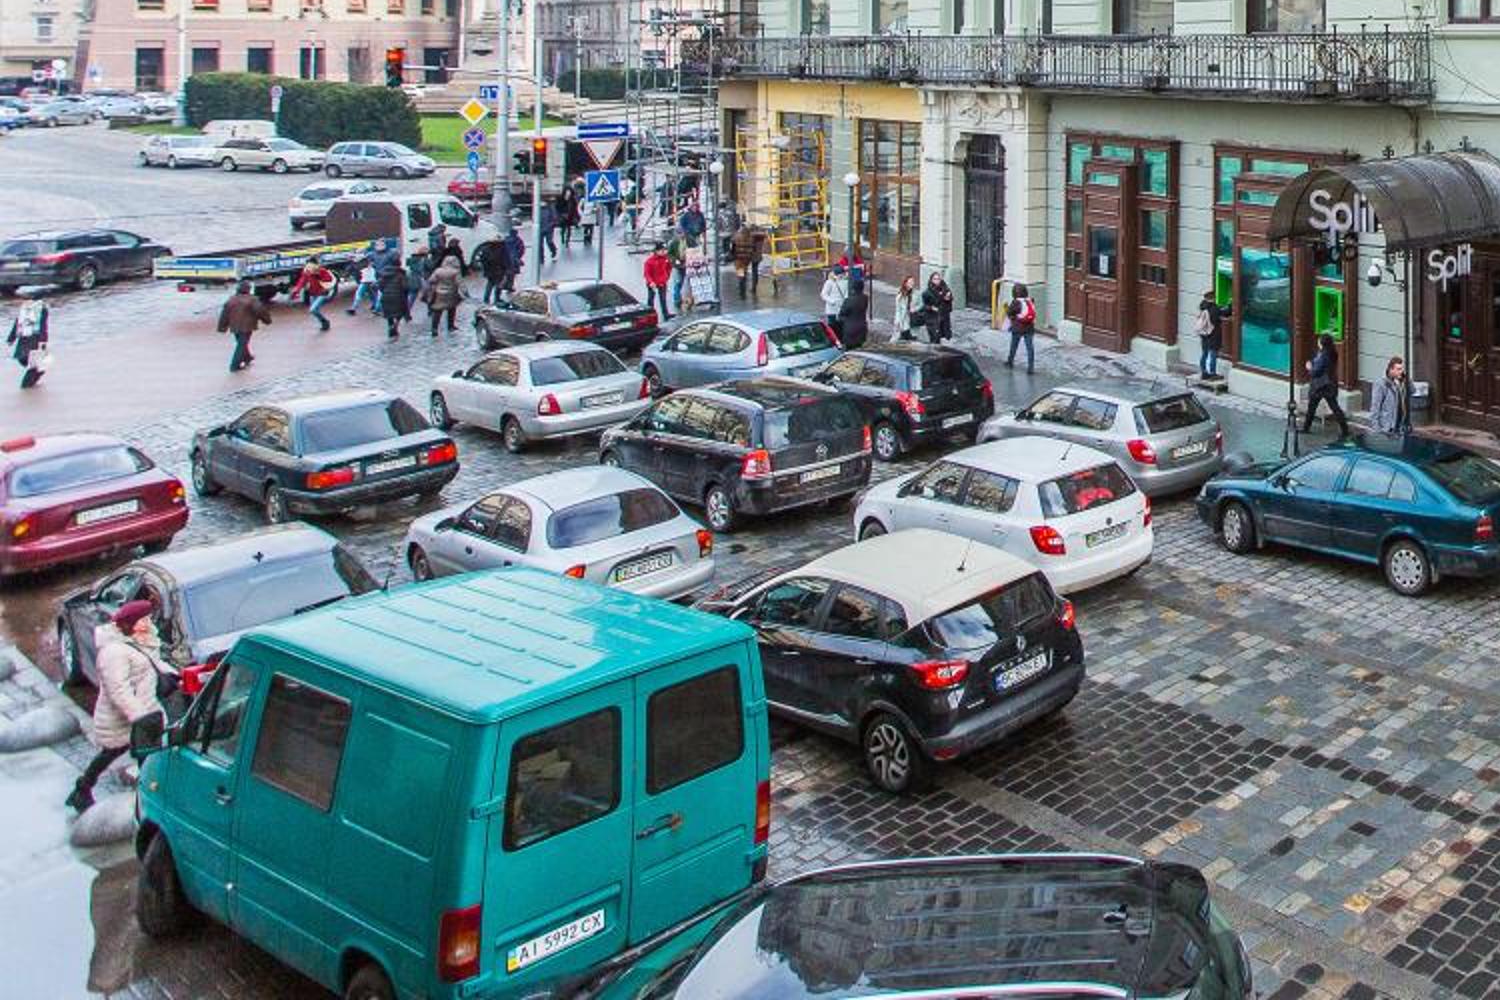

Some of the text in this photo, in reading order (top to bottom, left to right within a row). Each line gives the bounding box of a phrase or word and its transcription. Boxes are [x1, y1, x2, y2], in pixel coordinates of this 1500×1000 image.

[1428, 243, 1473, 293] Split
[544, 923, 578, 951] 5992
[581, 914, 601, 933] CX
